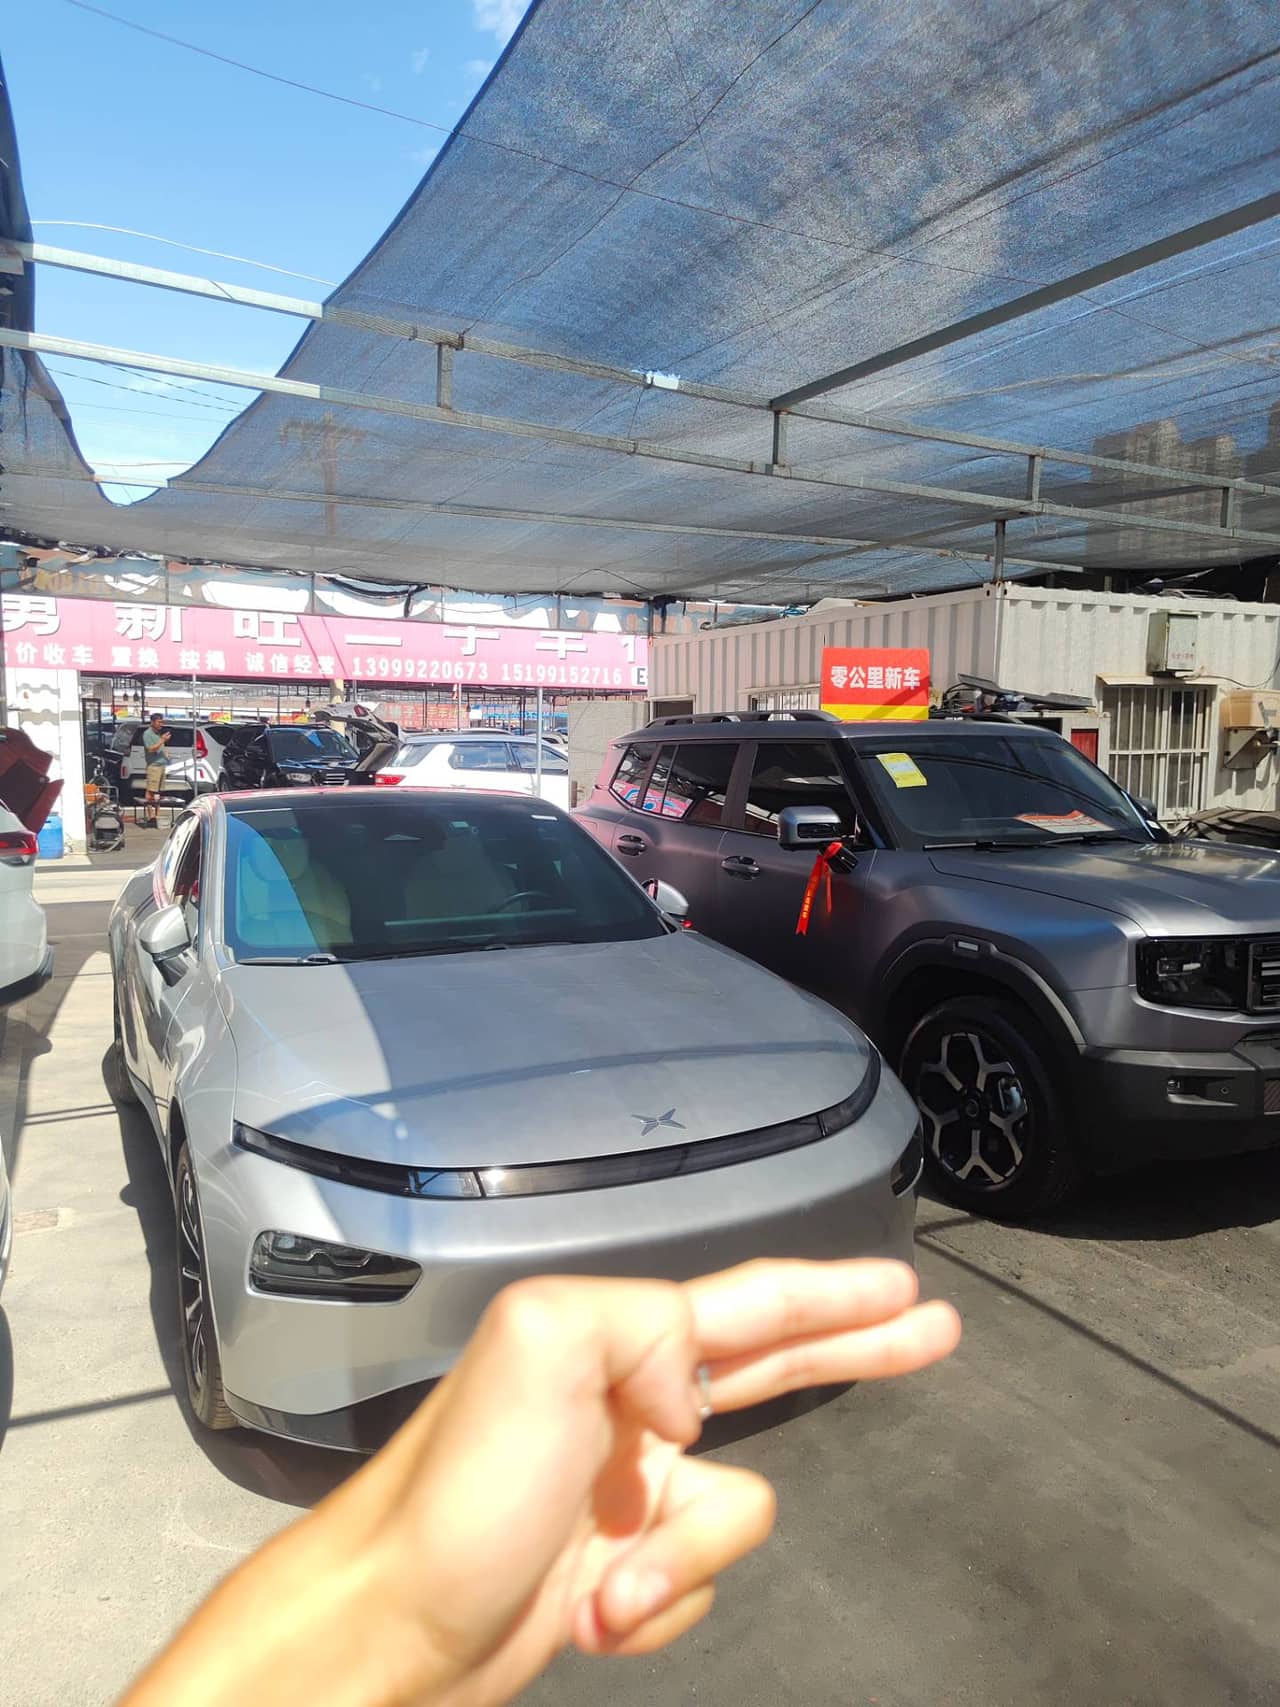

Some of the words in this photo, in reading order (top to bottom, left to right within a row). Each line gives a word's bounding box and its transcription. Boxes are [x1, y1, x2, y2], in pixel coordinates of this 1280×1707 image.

[4, 641, 94, 666] 价收车
[112, 646, 159, 669] 置换
[246, 651, 335, 675] 诚信经营
[352, 657, 488, 680] 13999220673
[502, 663, 623, 685] 15199152716
[831, 666, 920, 690] 零公里新车
